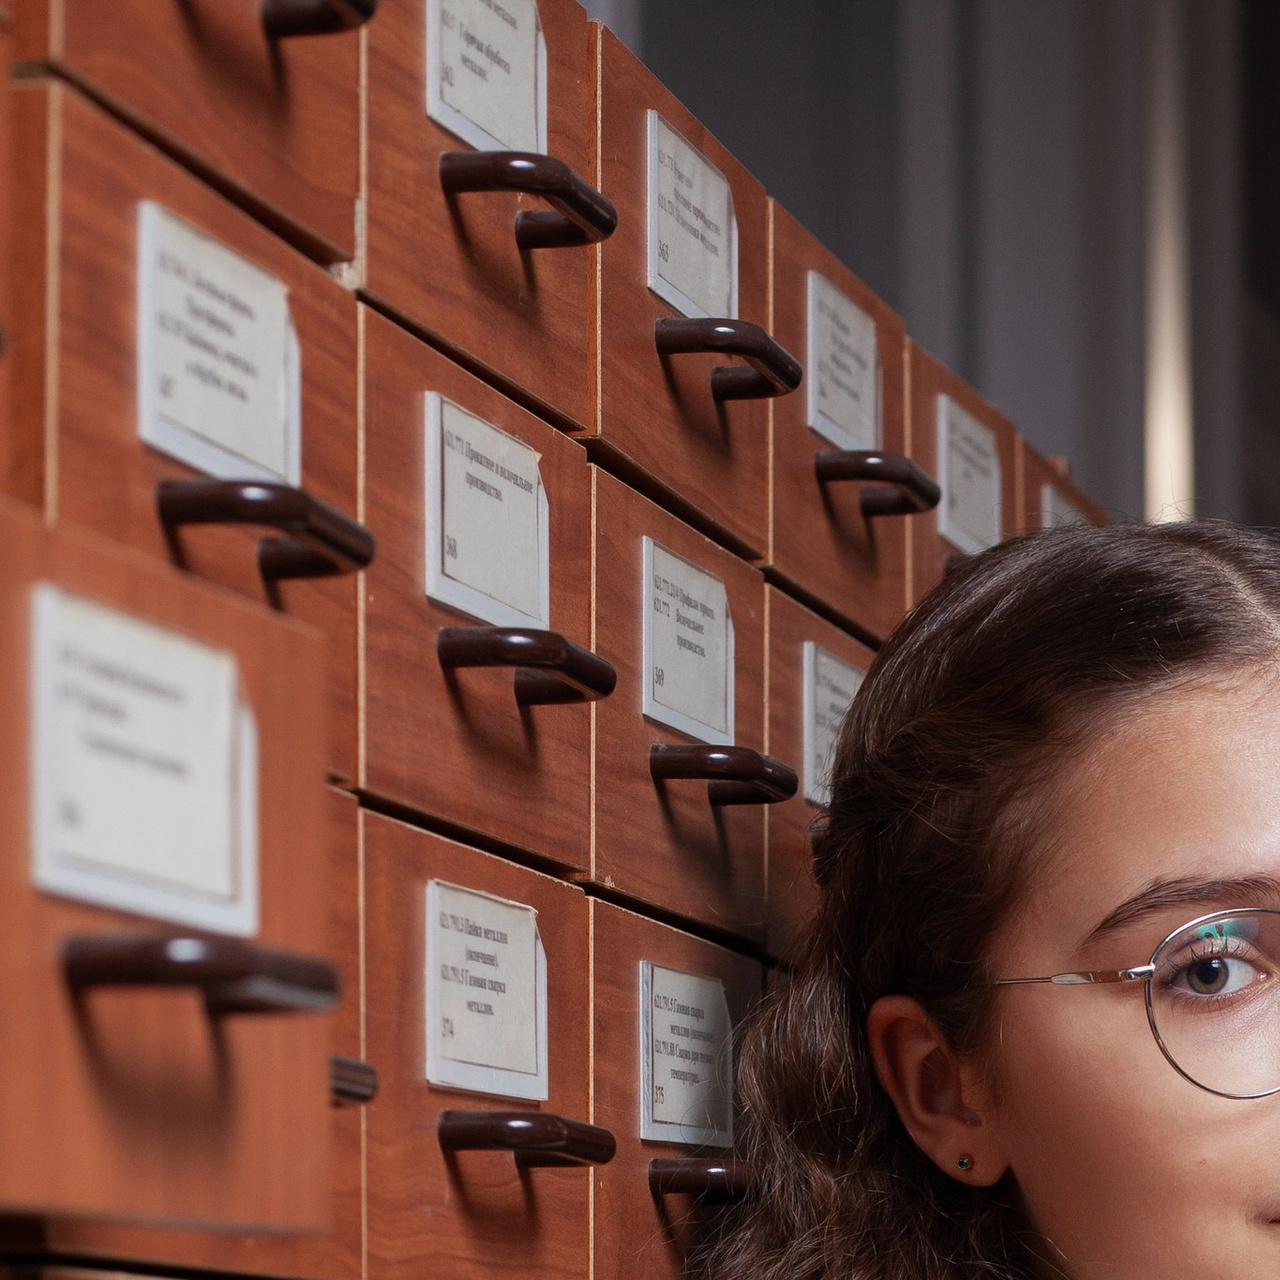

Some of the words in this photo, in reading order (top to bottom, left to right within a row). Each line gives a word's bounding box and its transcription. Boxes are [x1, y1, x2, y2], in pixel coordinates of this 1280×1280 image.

[658, 240, 668, 262] 363
[446, 535, 457, 559] 368
[655, 666, 664, 686] 369
[465, 916, 482, 938] Пайка
[465, 969, 487, 990] Газовая
[488, 977, 506, 996] сварка
[673, 999, 690, 1016] Газовая
[442, 1017, 454, 1040] 374
[676, 1043, 690, 1062] Сварка
[655, 1086, 664, 1104] 375
